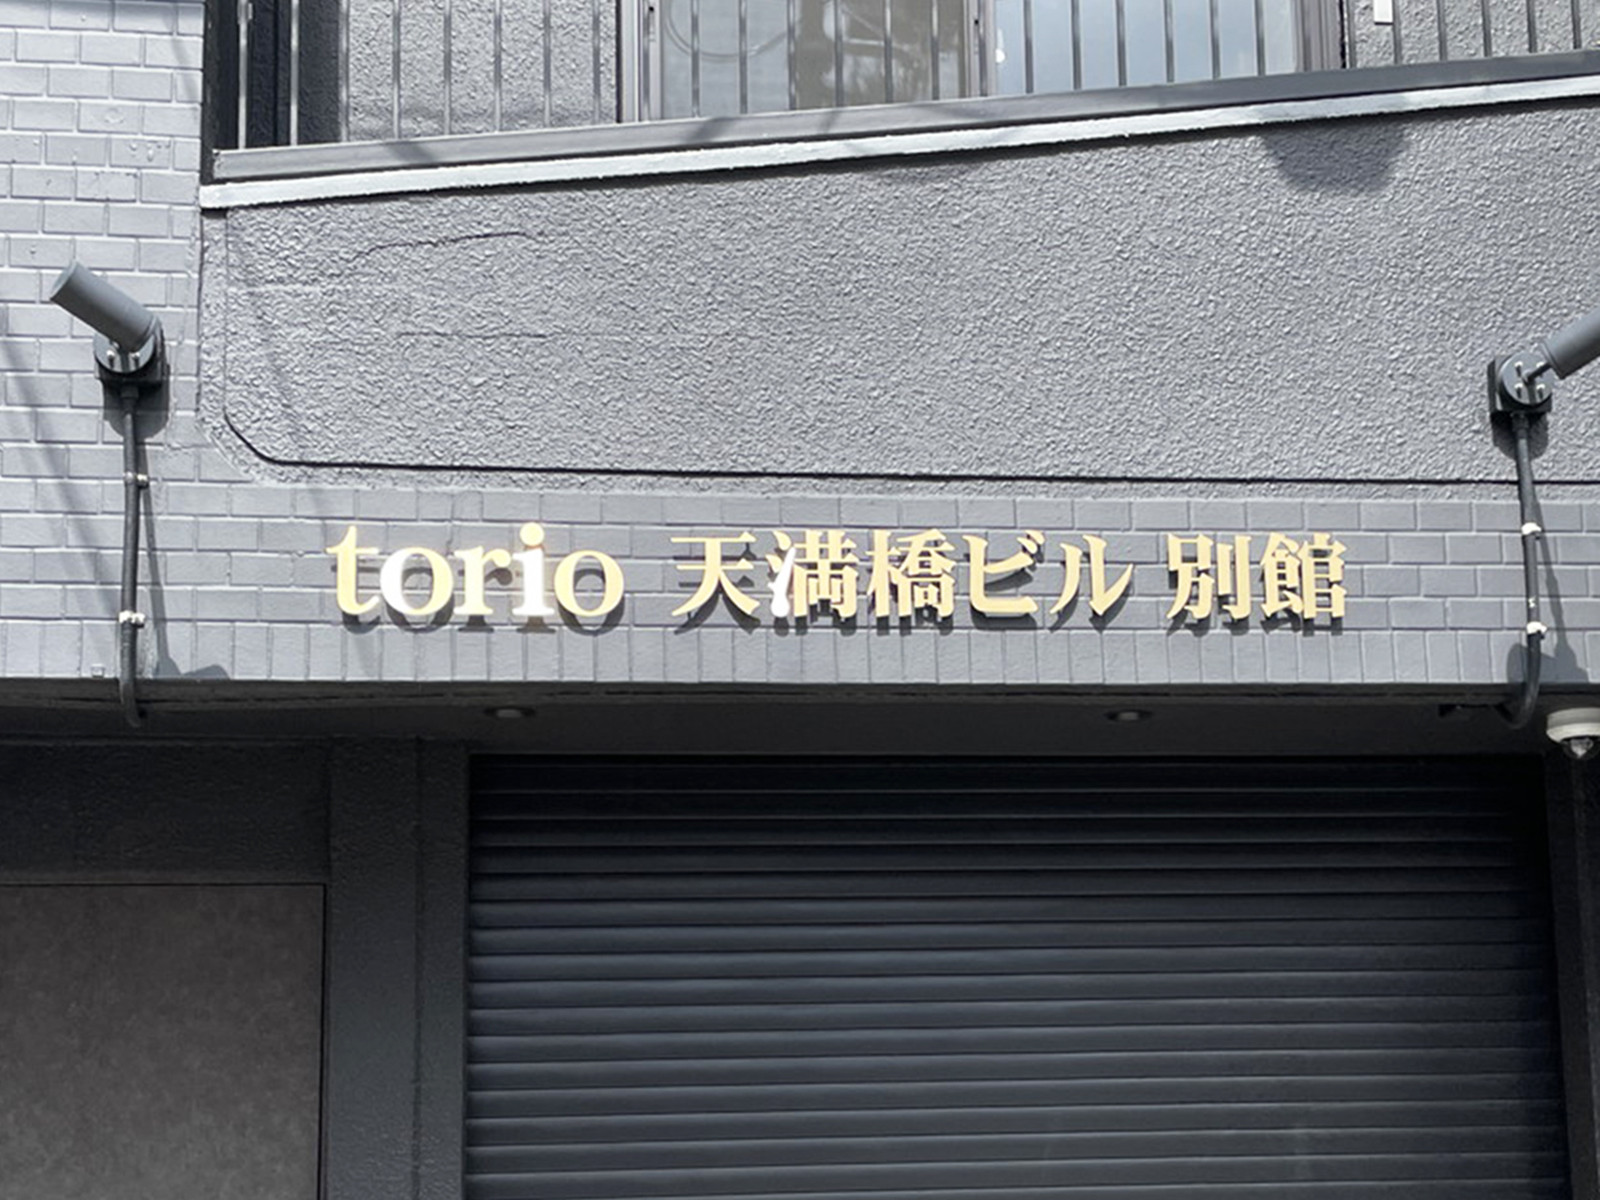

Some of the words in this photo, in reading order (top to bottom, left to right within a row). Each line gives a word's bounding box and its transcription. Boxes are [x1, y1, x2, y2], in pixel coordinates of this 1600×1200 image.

[326, 522, 624, 618] torio
[671, 528, 1134, 618] 天満橋ビル
[1166, 531, 1348, 620] 別館
